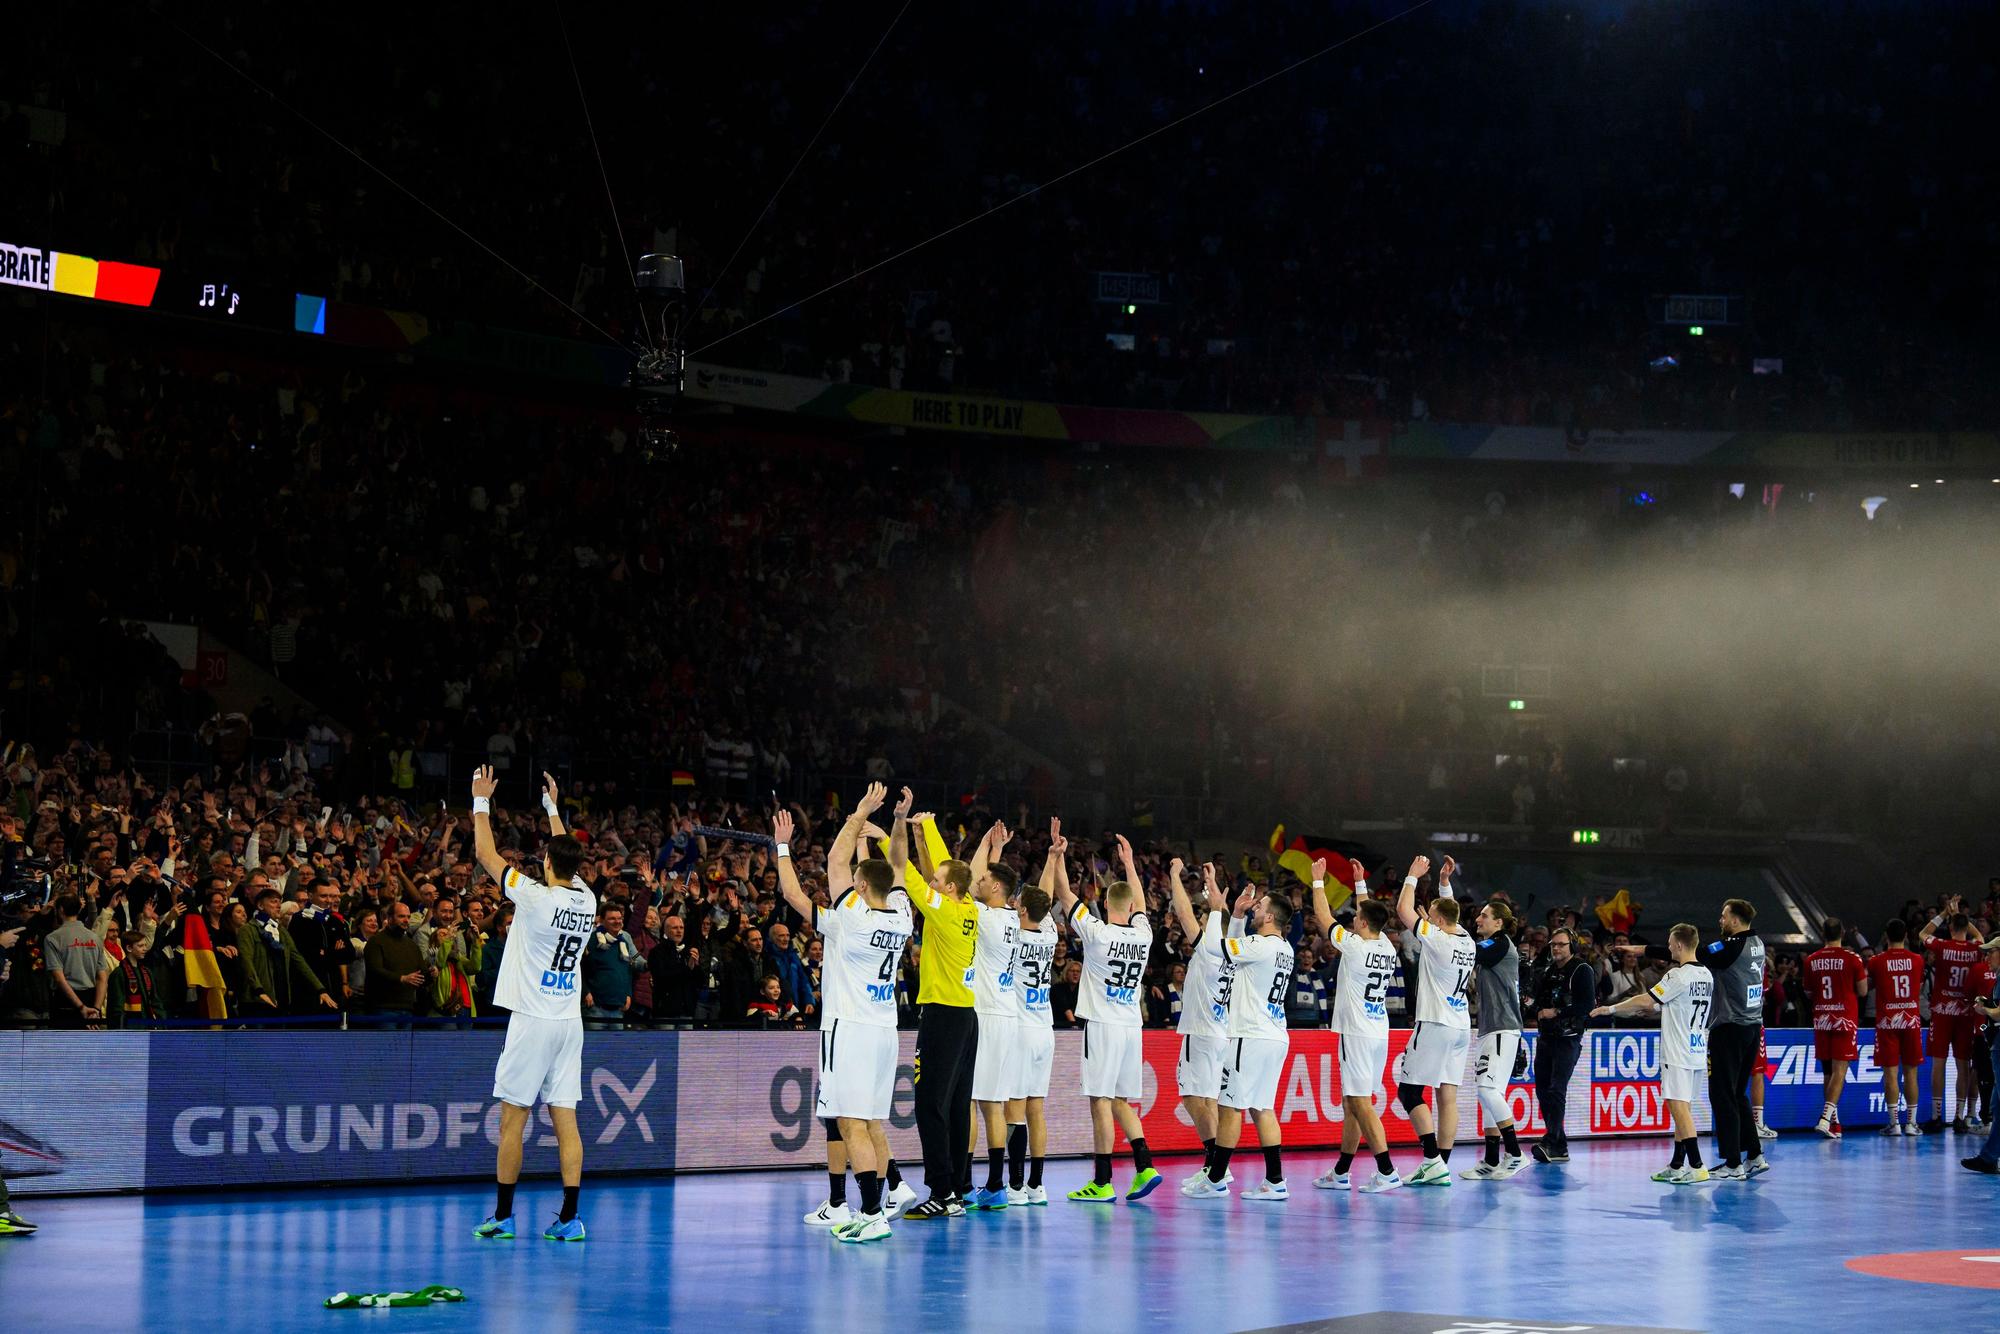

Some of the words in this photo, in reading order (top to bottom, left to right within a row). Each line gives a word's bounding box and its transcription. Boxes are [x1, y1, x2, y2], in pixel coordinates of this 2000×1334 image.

[913, 399, 952, 424] HERE
[958, 402, 977, 426] TO
[984, 404, 1022, 430] PLAY
[550, 934, 582, 972] 18
[1107, 941, 1147, 960] HANNE
[1811, 959, 1844, 971] MEISTER
[878, 951, 894, 982] 4
[1105, 960, 1142, 989] 38
[1886, 959, 1912, 972] KUSIO
[1822, 975, 1833, 1000] 3
[1892, 975, 1911, 998] 13
[1595, 1035, 1661, 1080] LIQU
[1594, 1085, 1666, 1129] MOLY
